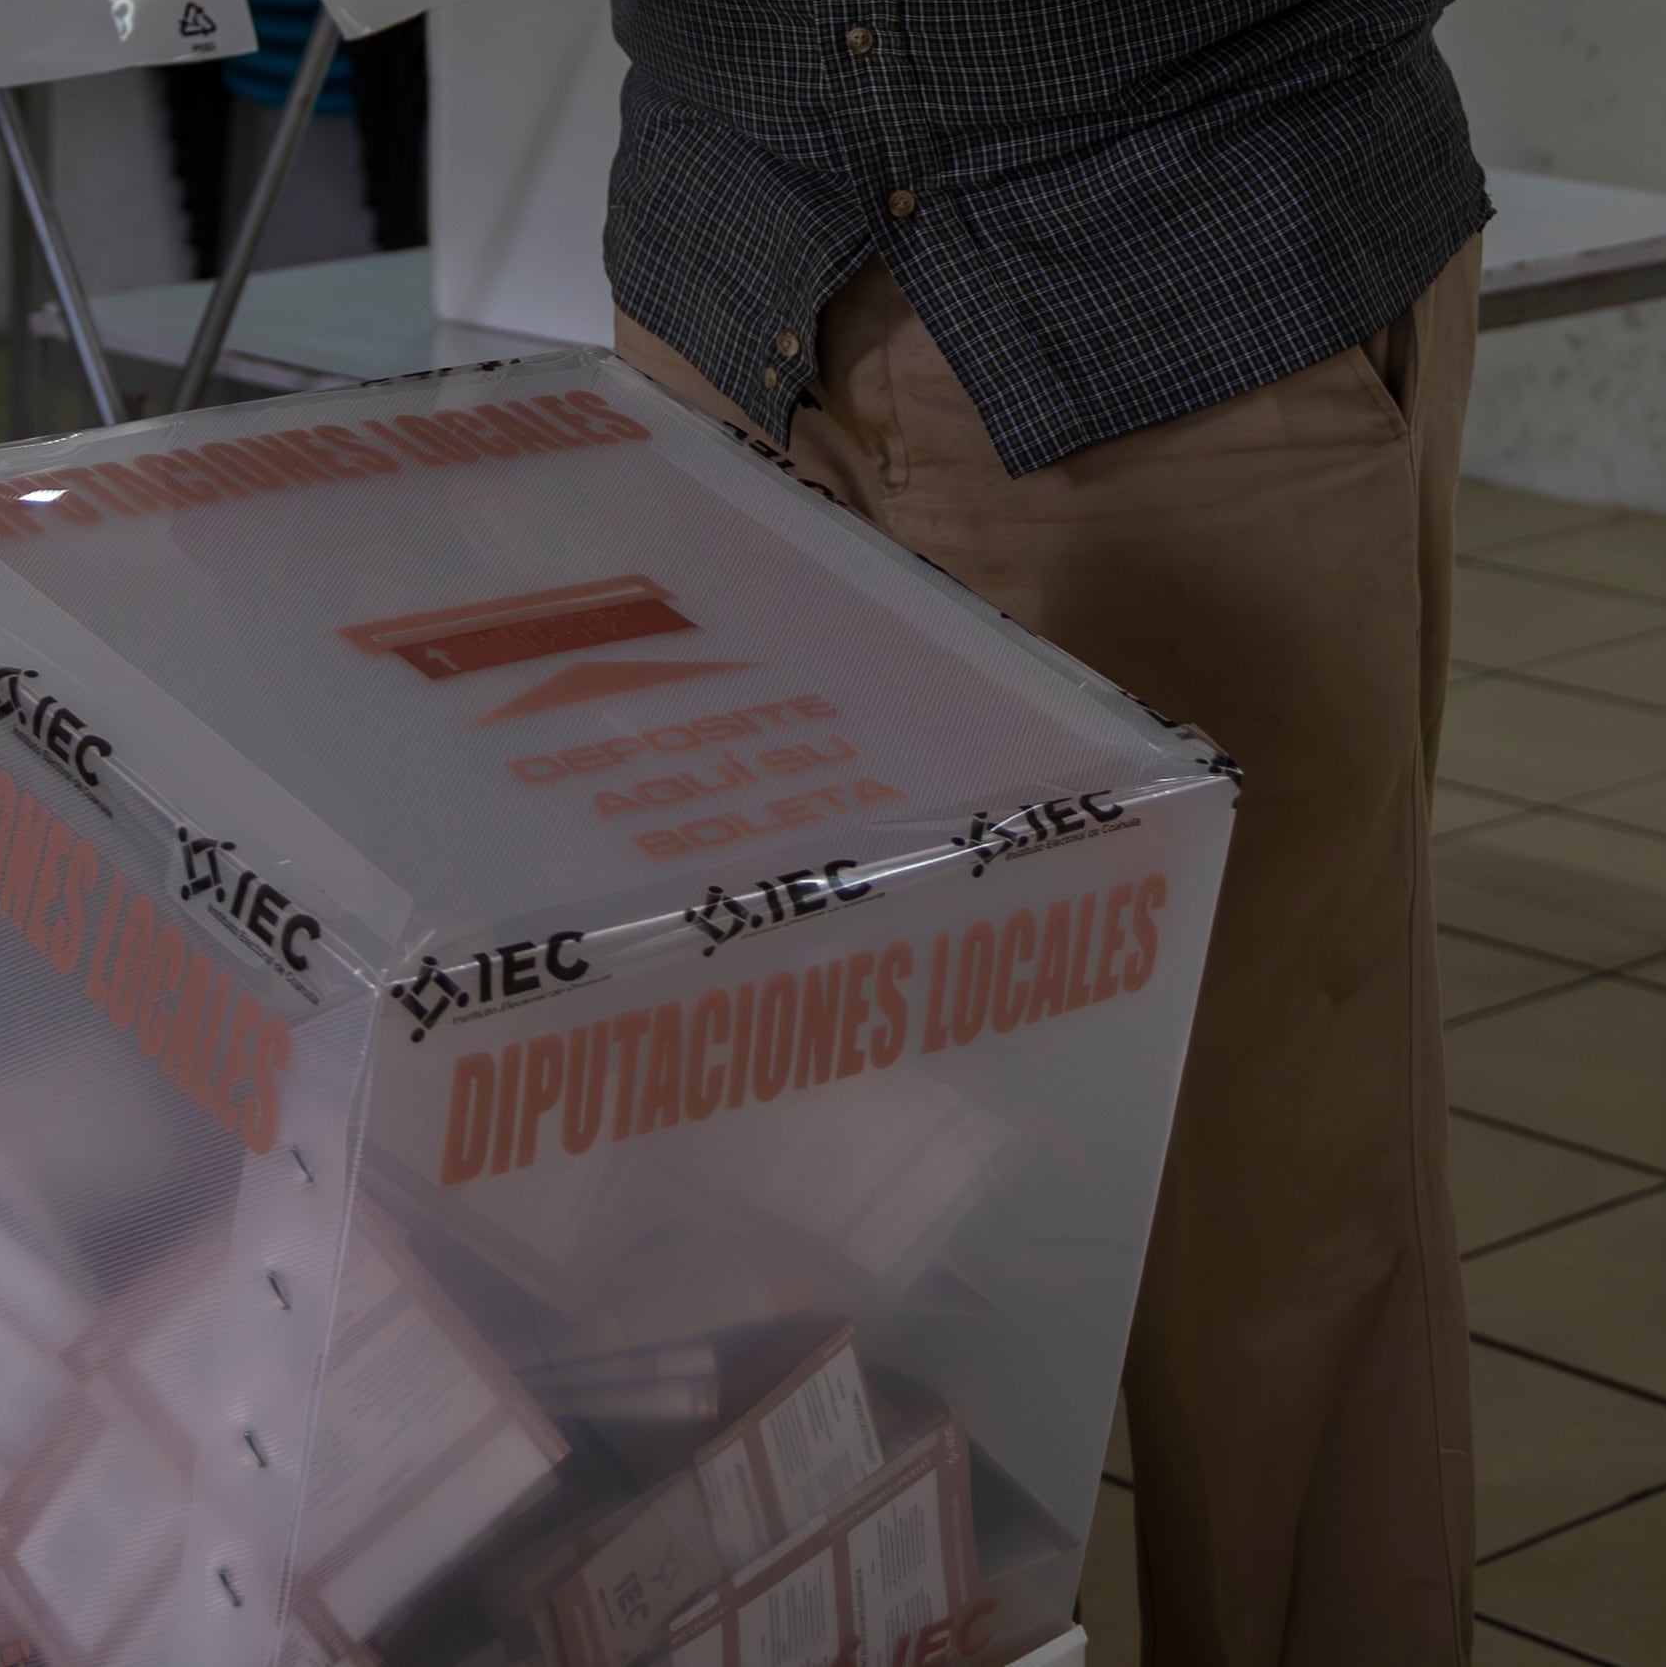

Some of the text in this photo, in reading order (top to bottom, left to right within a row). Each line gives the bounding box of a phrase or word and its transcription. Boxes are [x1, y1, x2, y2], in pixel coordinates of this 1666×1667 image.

[363, 389, 652, 470] LOCALES
[33, 695, 113, 787] IEC
[507, 694, 840, 786] DEPOSITE
[757, 735, 861, 774] SU
[633, 776, 909, 861] BOLETA
[1019, 790, 1124, 842] IEC
[230, 870, 322, 972] IEC
[755, 859, 873, 924] IEC
[474, 931, 590, 1003] IEC
[85, 873, 291, 1155] LOCALES
[440, 940, 915, 1187] DIPUTACIONES
[921, 871, 1168, 1056] LOCALES
